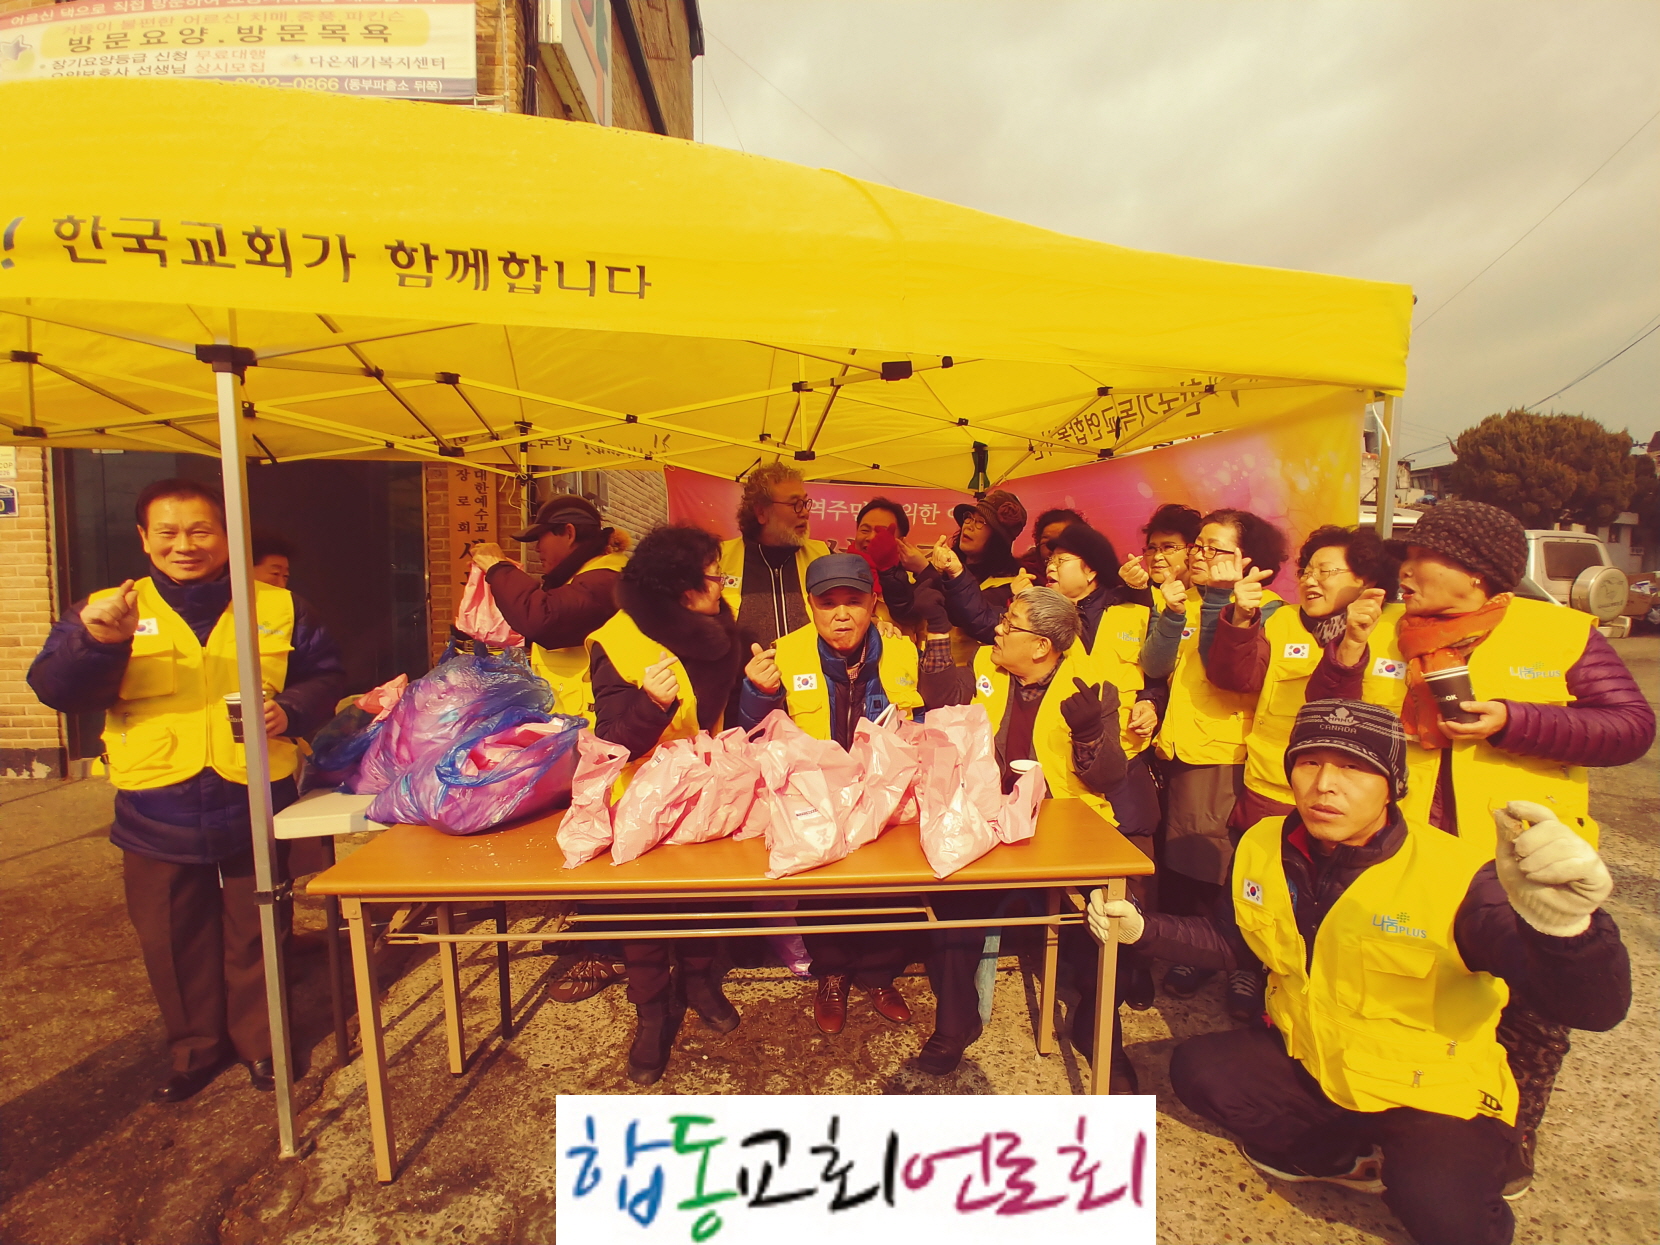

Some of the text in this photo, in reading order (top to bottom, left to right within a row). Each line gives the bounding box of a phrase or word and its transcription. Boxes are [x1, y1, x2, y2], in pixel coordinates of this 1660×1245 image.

[11, 10, 54, 25] 어르신
[60, 4, 106, 18] 댁으로
[63, 21, 112, 35] 거동이
[121, 16, 175, 30] 불편한
[183, 12, 240, 25] 어르신
[52, 49, 266, 70] 장기요양등급 신청 무료대행
[136, 63, 187, 76] 선생님
[195, 62, 265, 74] 상시모집
[53, 215, 356, 283] 한국교회가
[384, 239, 652, 300] 함께합니다
[474, 469, 490, 533] 대한예수교
[1319, 724, 1357, 735] CANADA
